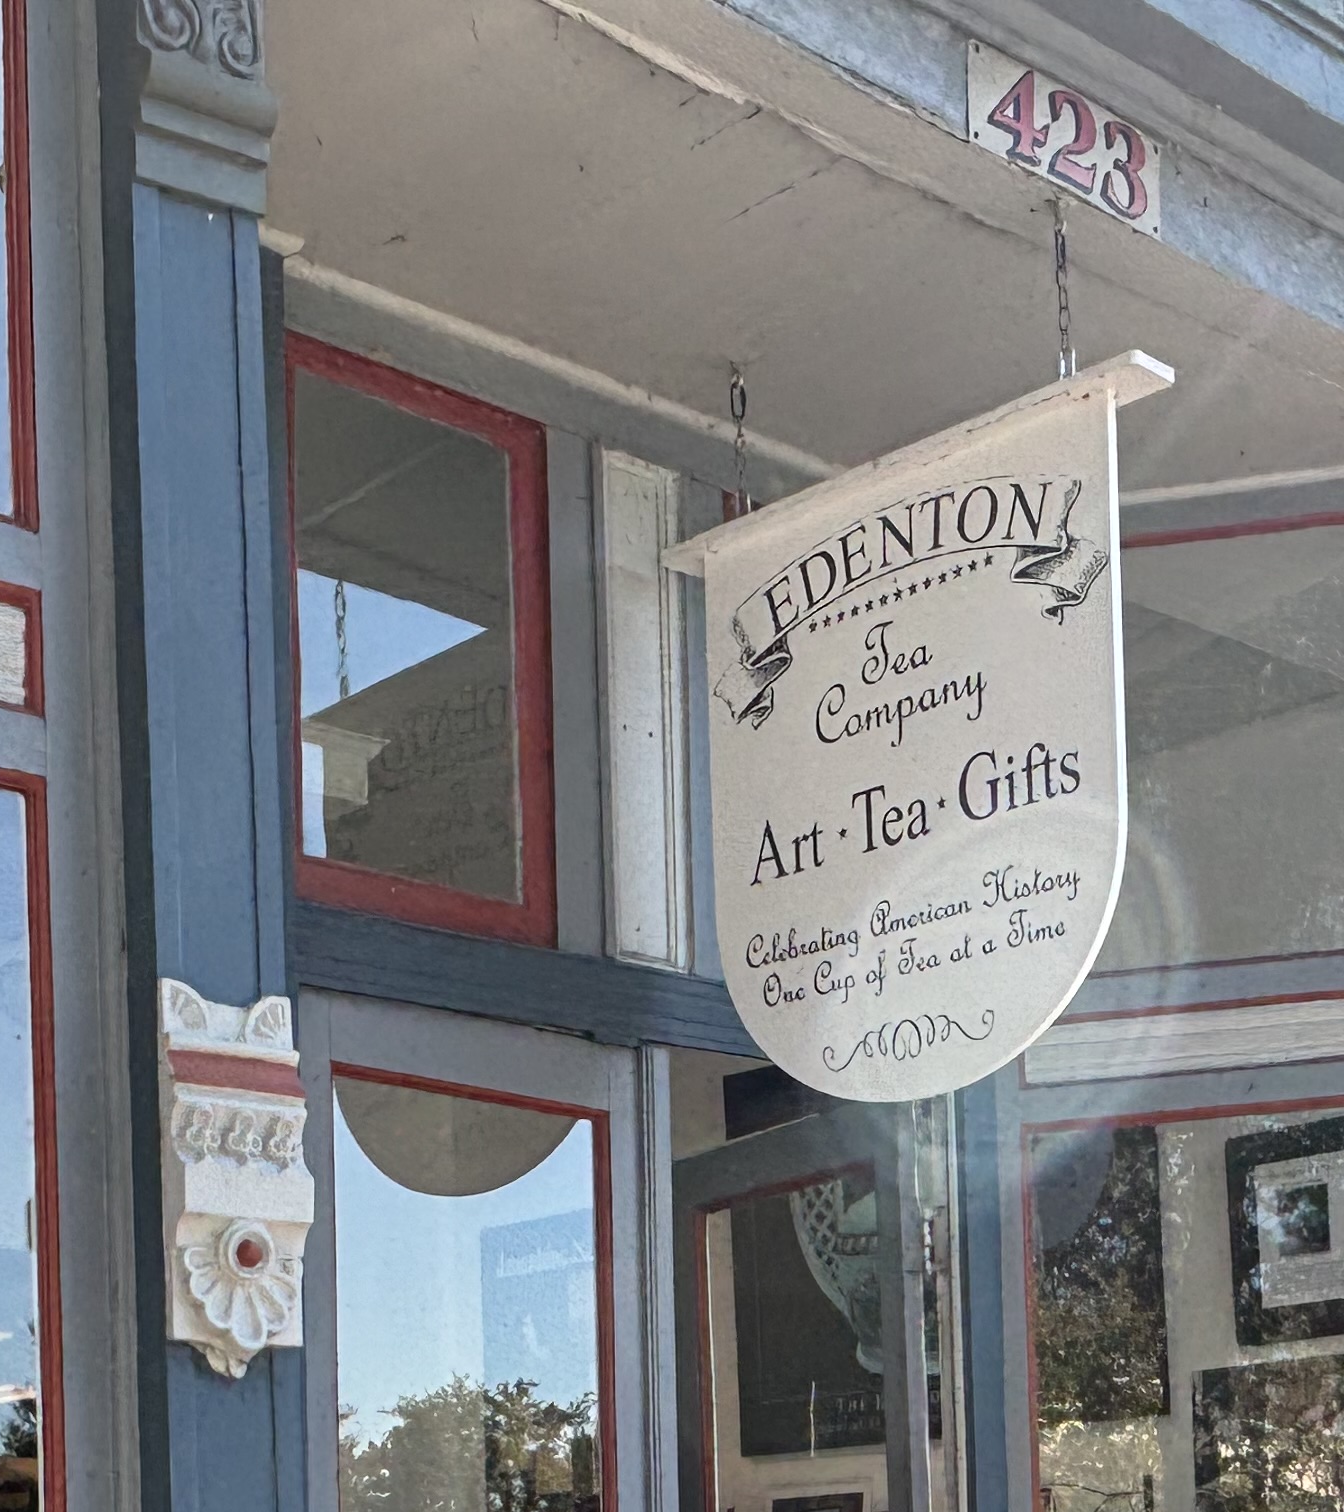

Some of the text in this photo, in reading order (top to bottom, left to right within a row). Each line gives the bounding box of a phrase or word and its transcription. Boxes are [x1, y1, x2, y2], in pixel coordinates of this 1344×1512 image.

[987, 69, 1148, 220] 423
[763, 482, 1053, 637] EDENTON
[861, 620, 934, 685] Tea
[815, 671, 987, 748] Company
[750, 742, 1081, 886] Art Tea Gifts
[745, 864, 1081, 969] Celebrating American History
[763, 908, 1066, 1008] One Cup of Tea at a Time
